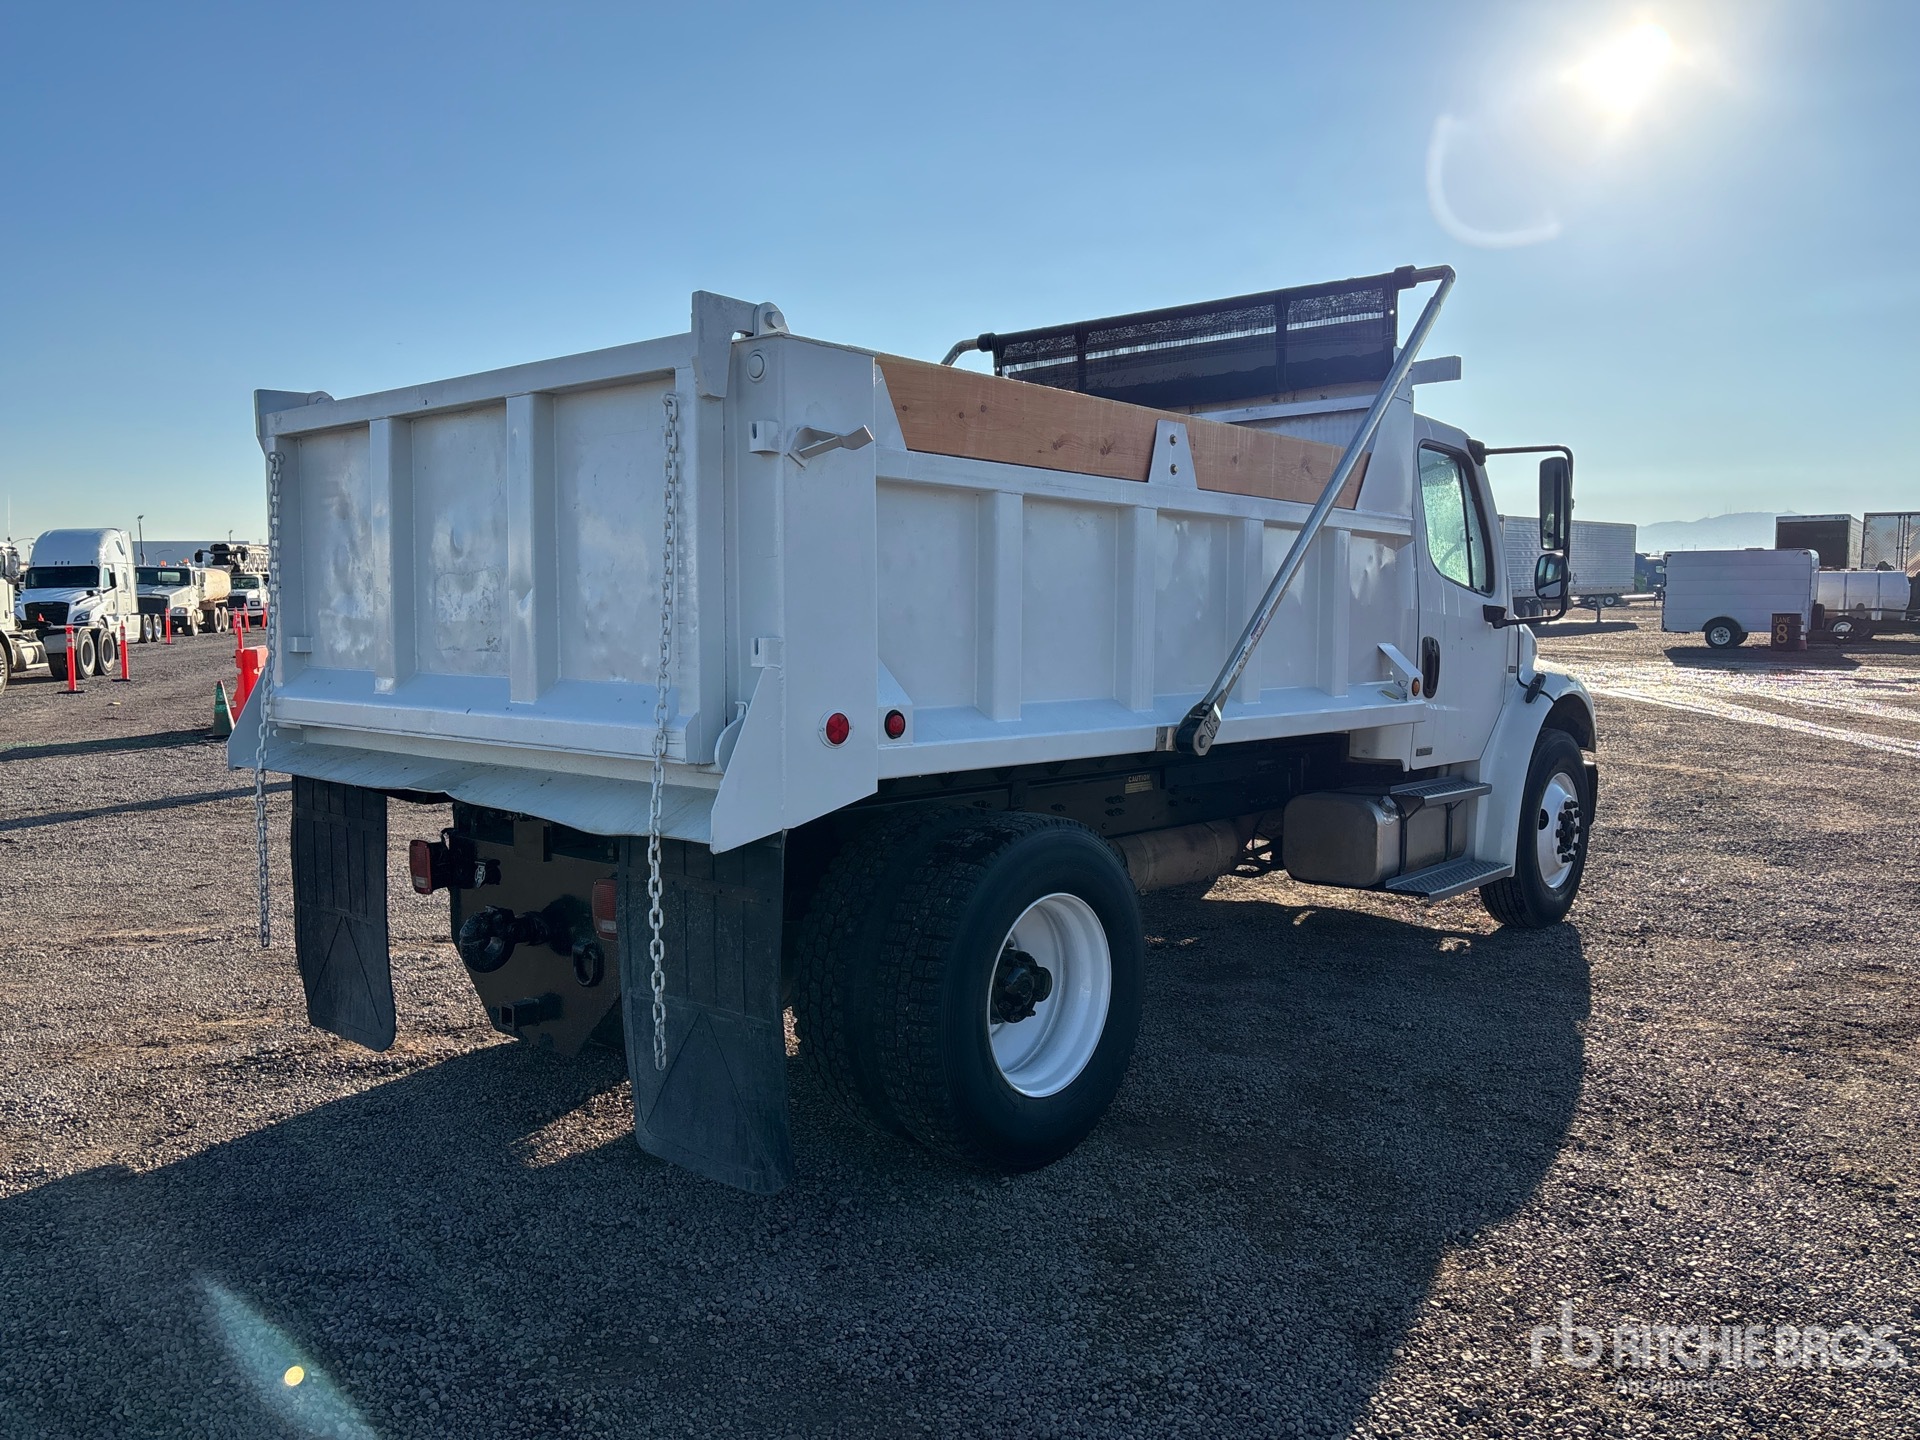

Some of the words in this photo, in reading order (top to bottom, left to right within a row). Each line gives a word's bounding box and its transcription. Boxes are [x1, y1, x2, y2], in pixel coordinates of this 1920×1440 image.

[1775, 616, 1791, 624] LANE
[1776, 624, 1788, 644] 8
[1128, 774, 1151, 783] CAUTION
